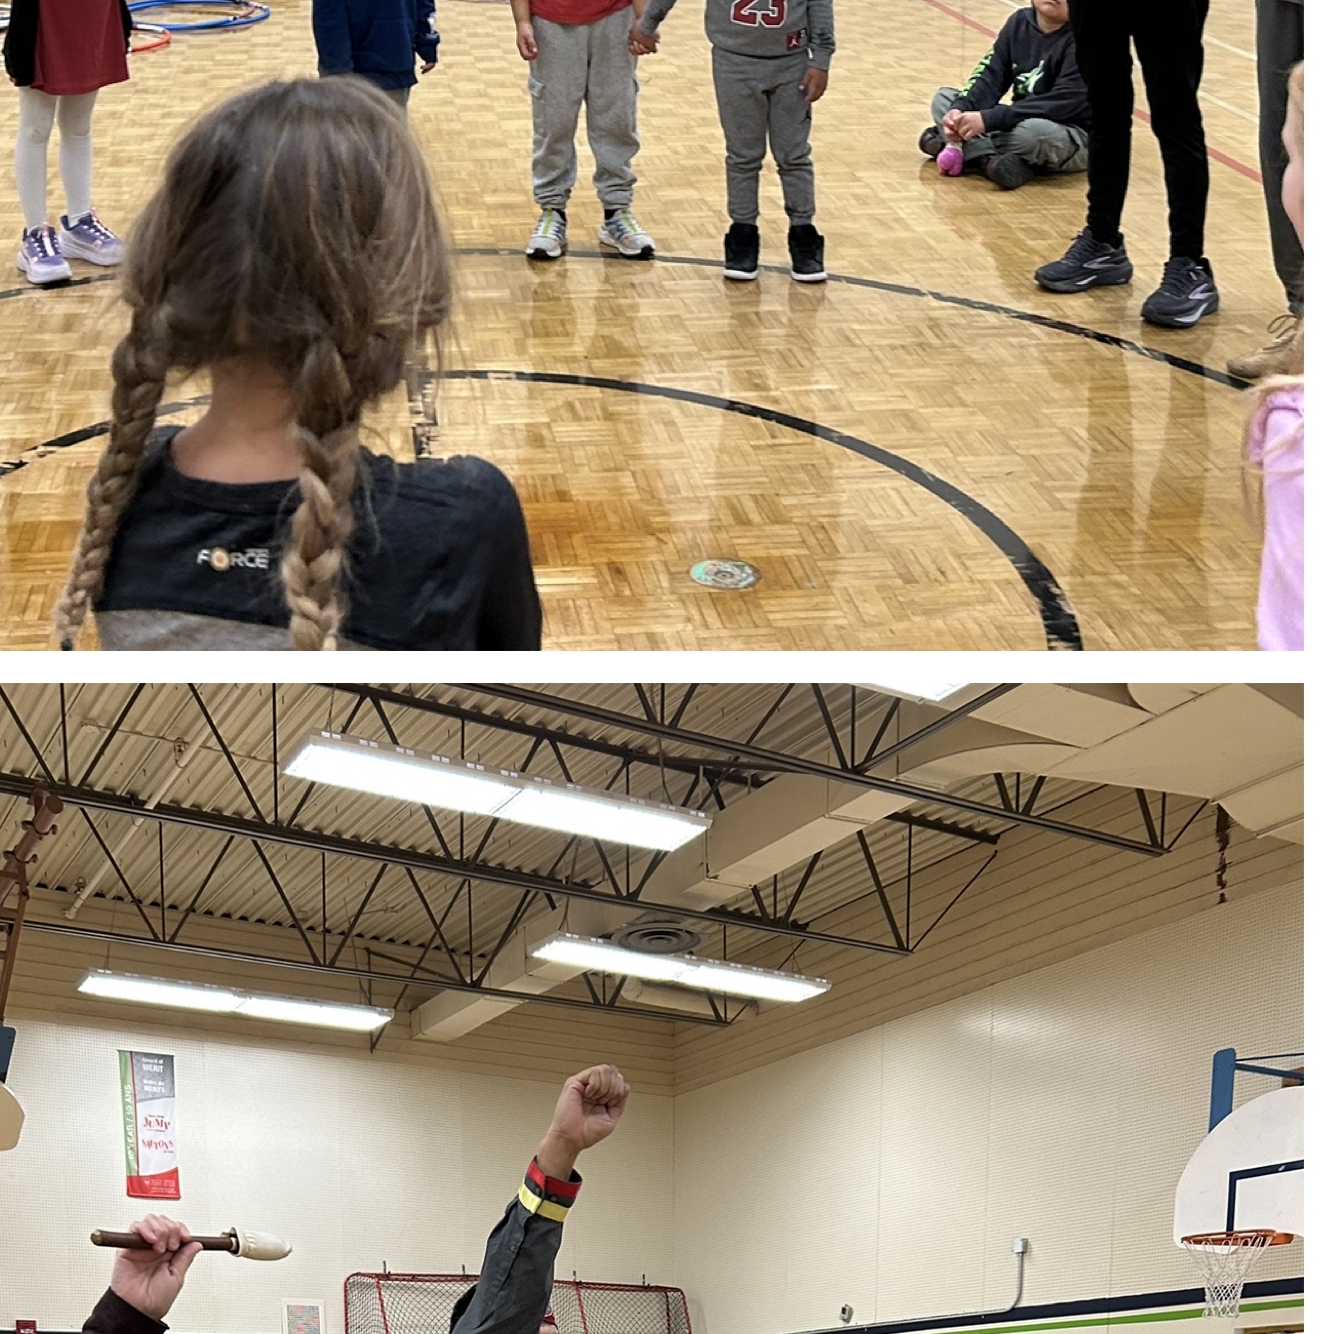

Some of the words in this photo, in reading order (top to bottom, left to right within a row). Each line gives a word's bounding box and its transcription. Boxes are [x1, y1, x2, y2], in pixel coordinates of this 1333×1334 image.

[197, 548, 269, 572] FORCE
[142, 1063, 164, 1073] MERIT
[123, 1084, 132, 1103] ANS
[125, 1104, 133, 1116] 10
[143, 1117, 171, 1130] JUMP
